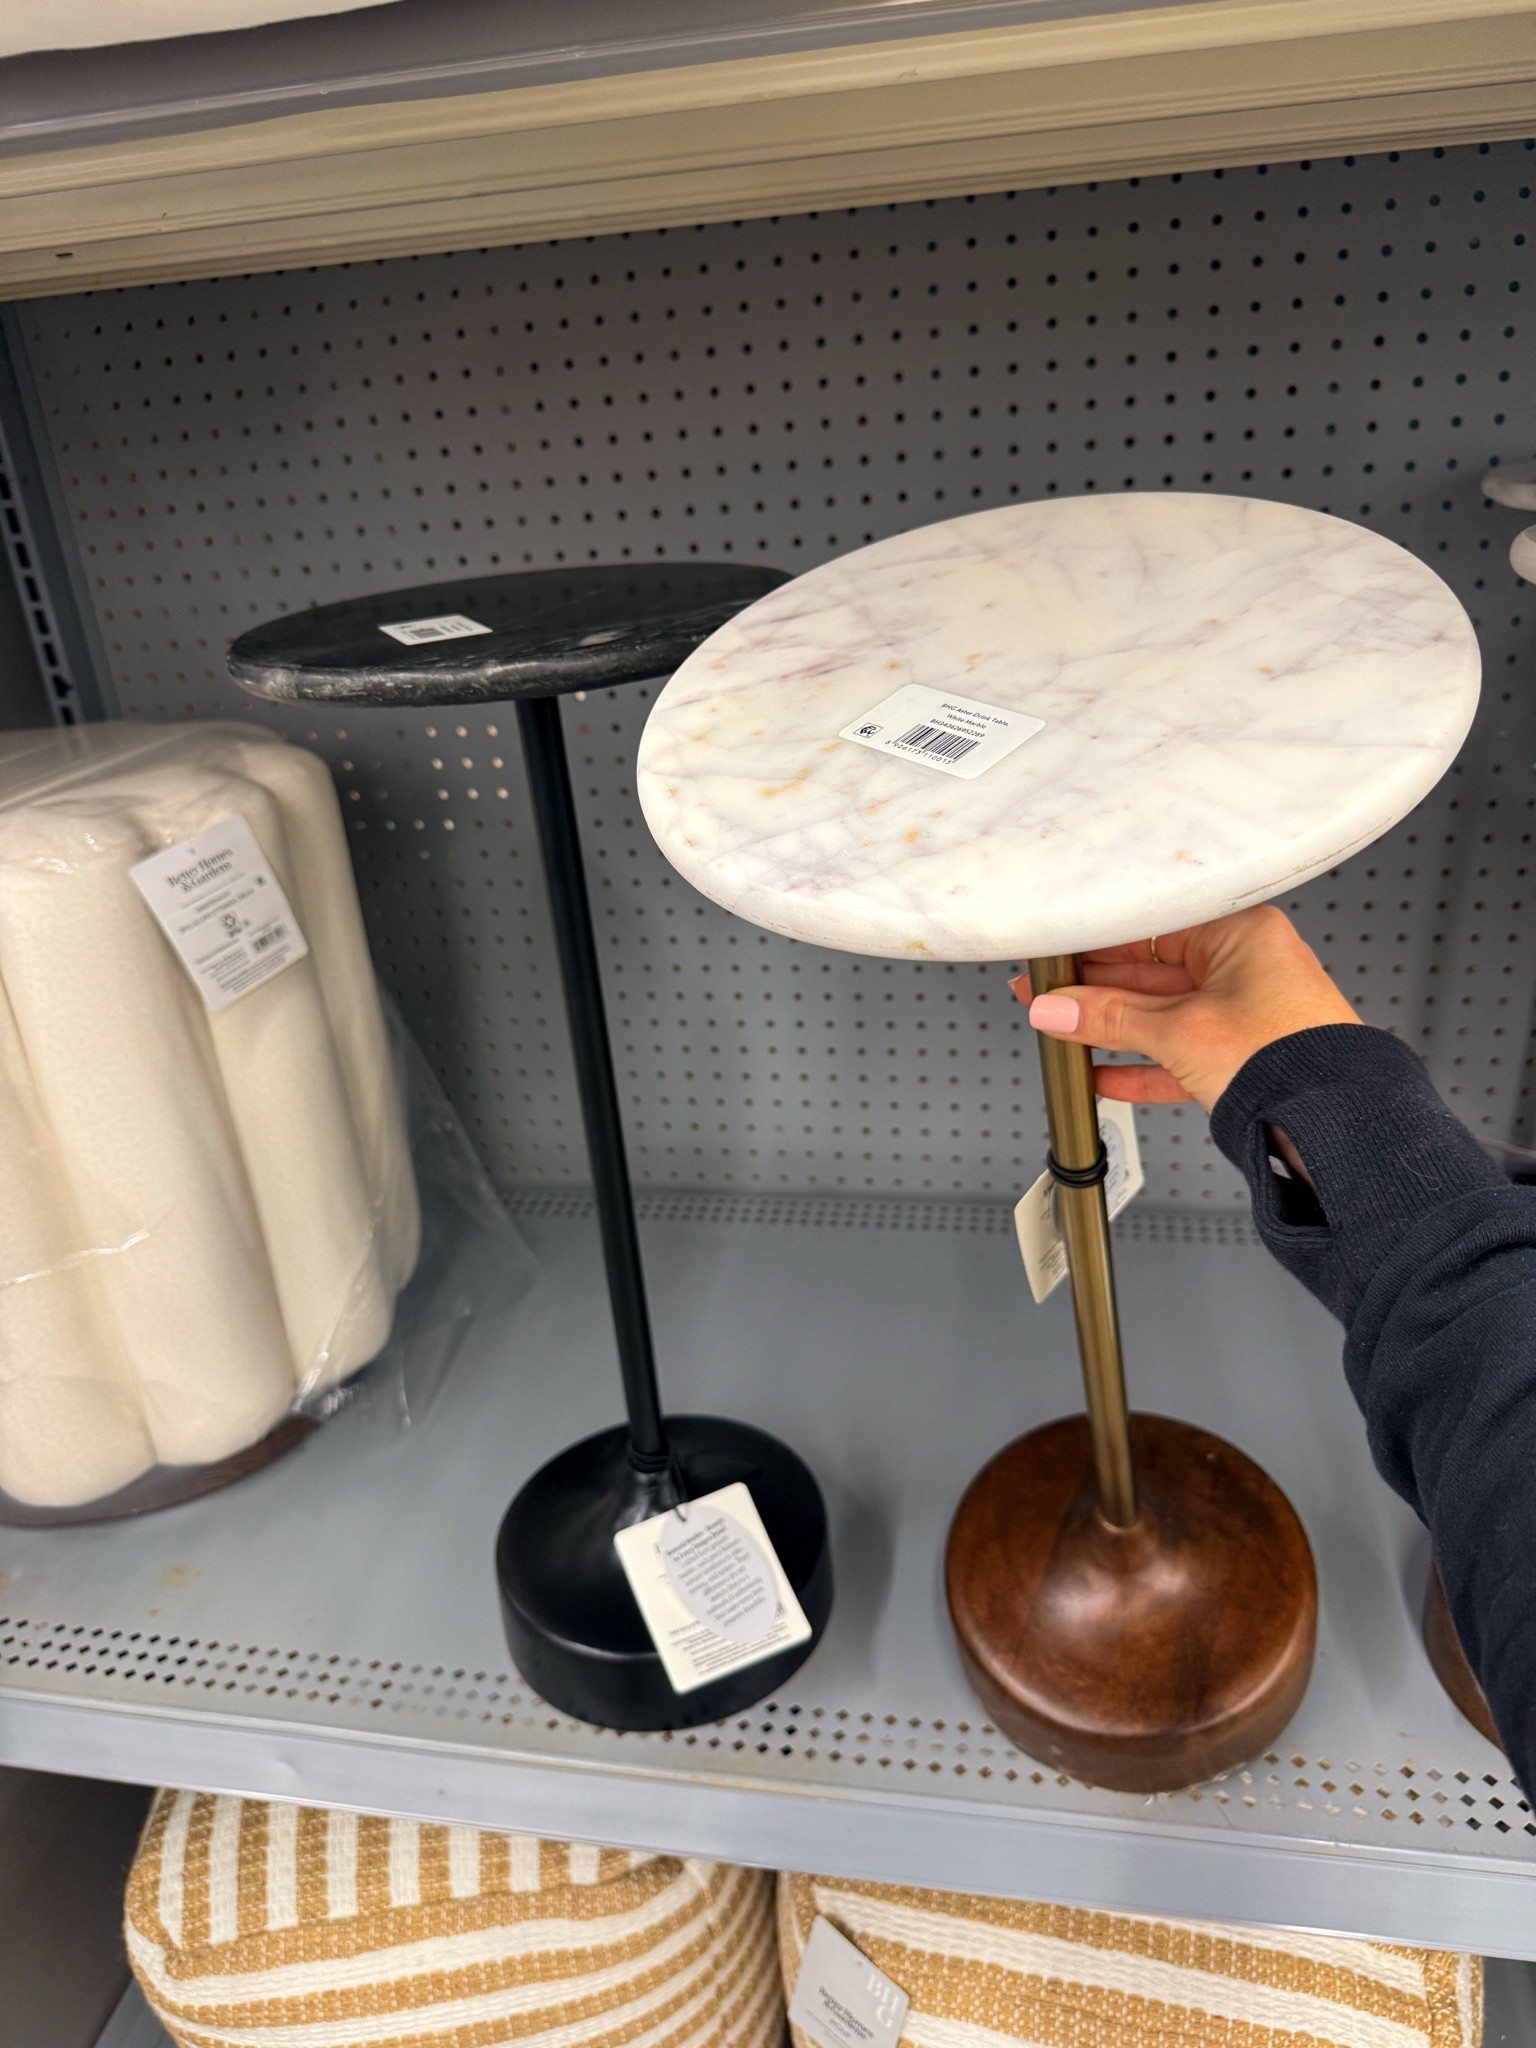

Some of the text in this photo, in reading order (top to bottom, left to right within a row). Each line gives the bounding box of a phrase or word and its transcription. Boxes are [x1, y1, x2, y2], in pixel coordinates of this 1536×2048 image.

[941, 703, 957, 711] BHG
[956, 708, 973, 716] Aster
[973, 712, 991, 721] Drink
[947, 713, 987, 729] White Marble
[167, 849, 233, 887] Better Homes
